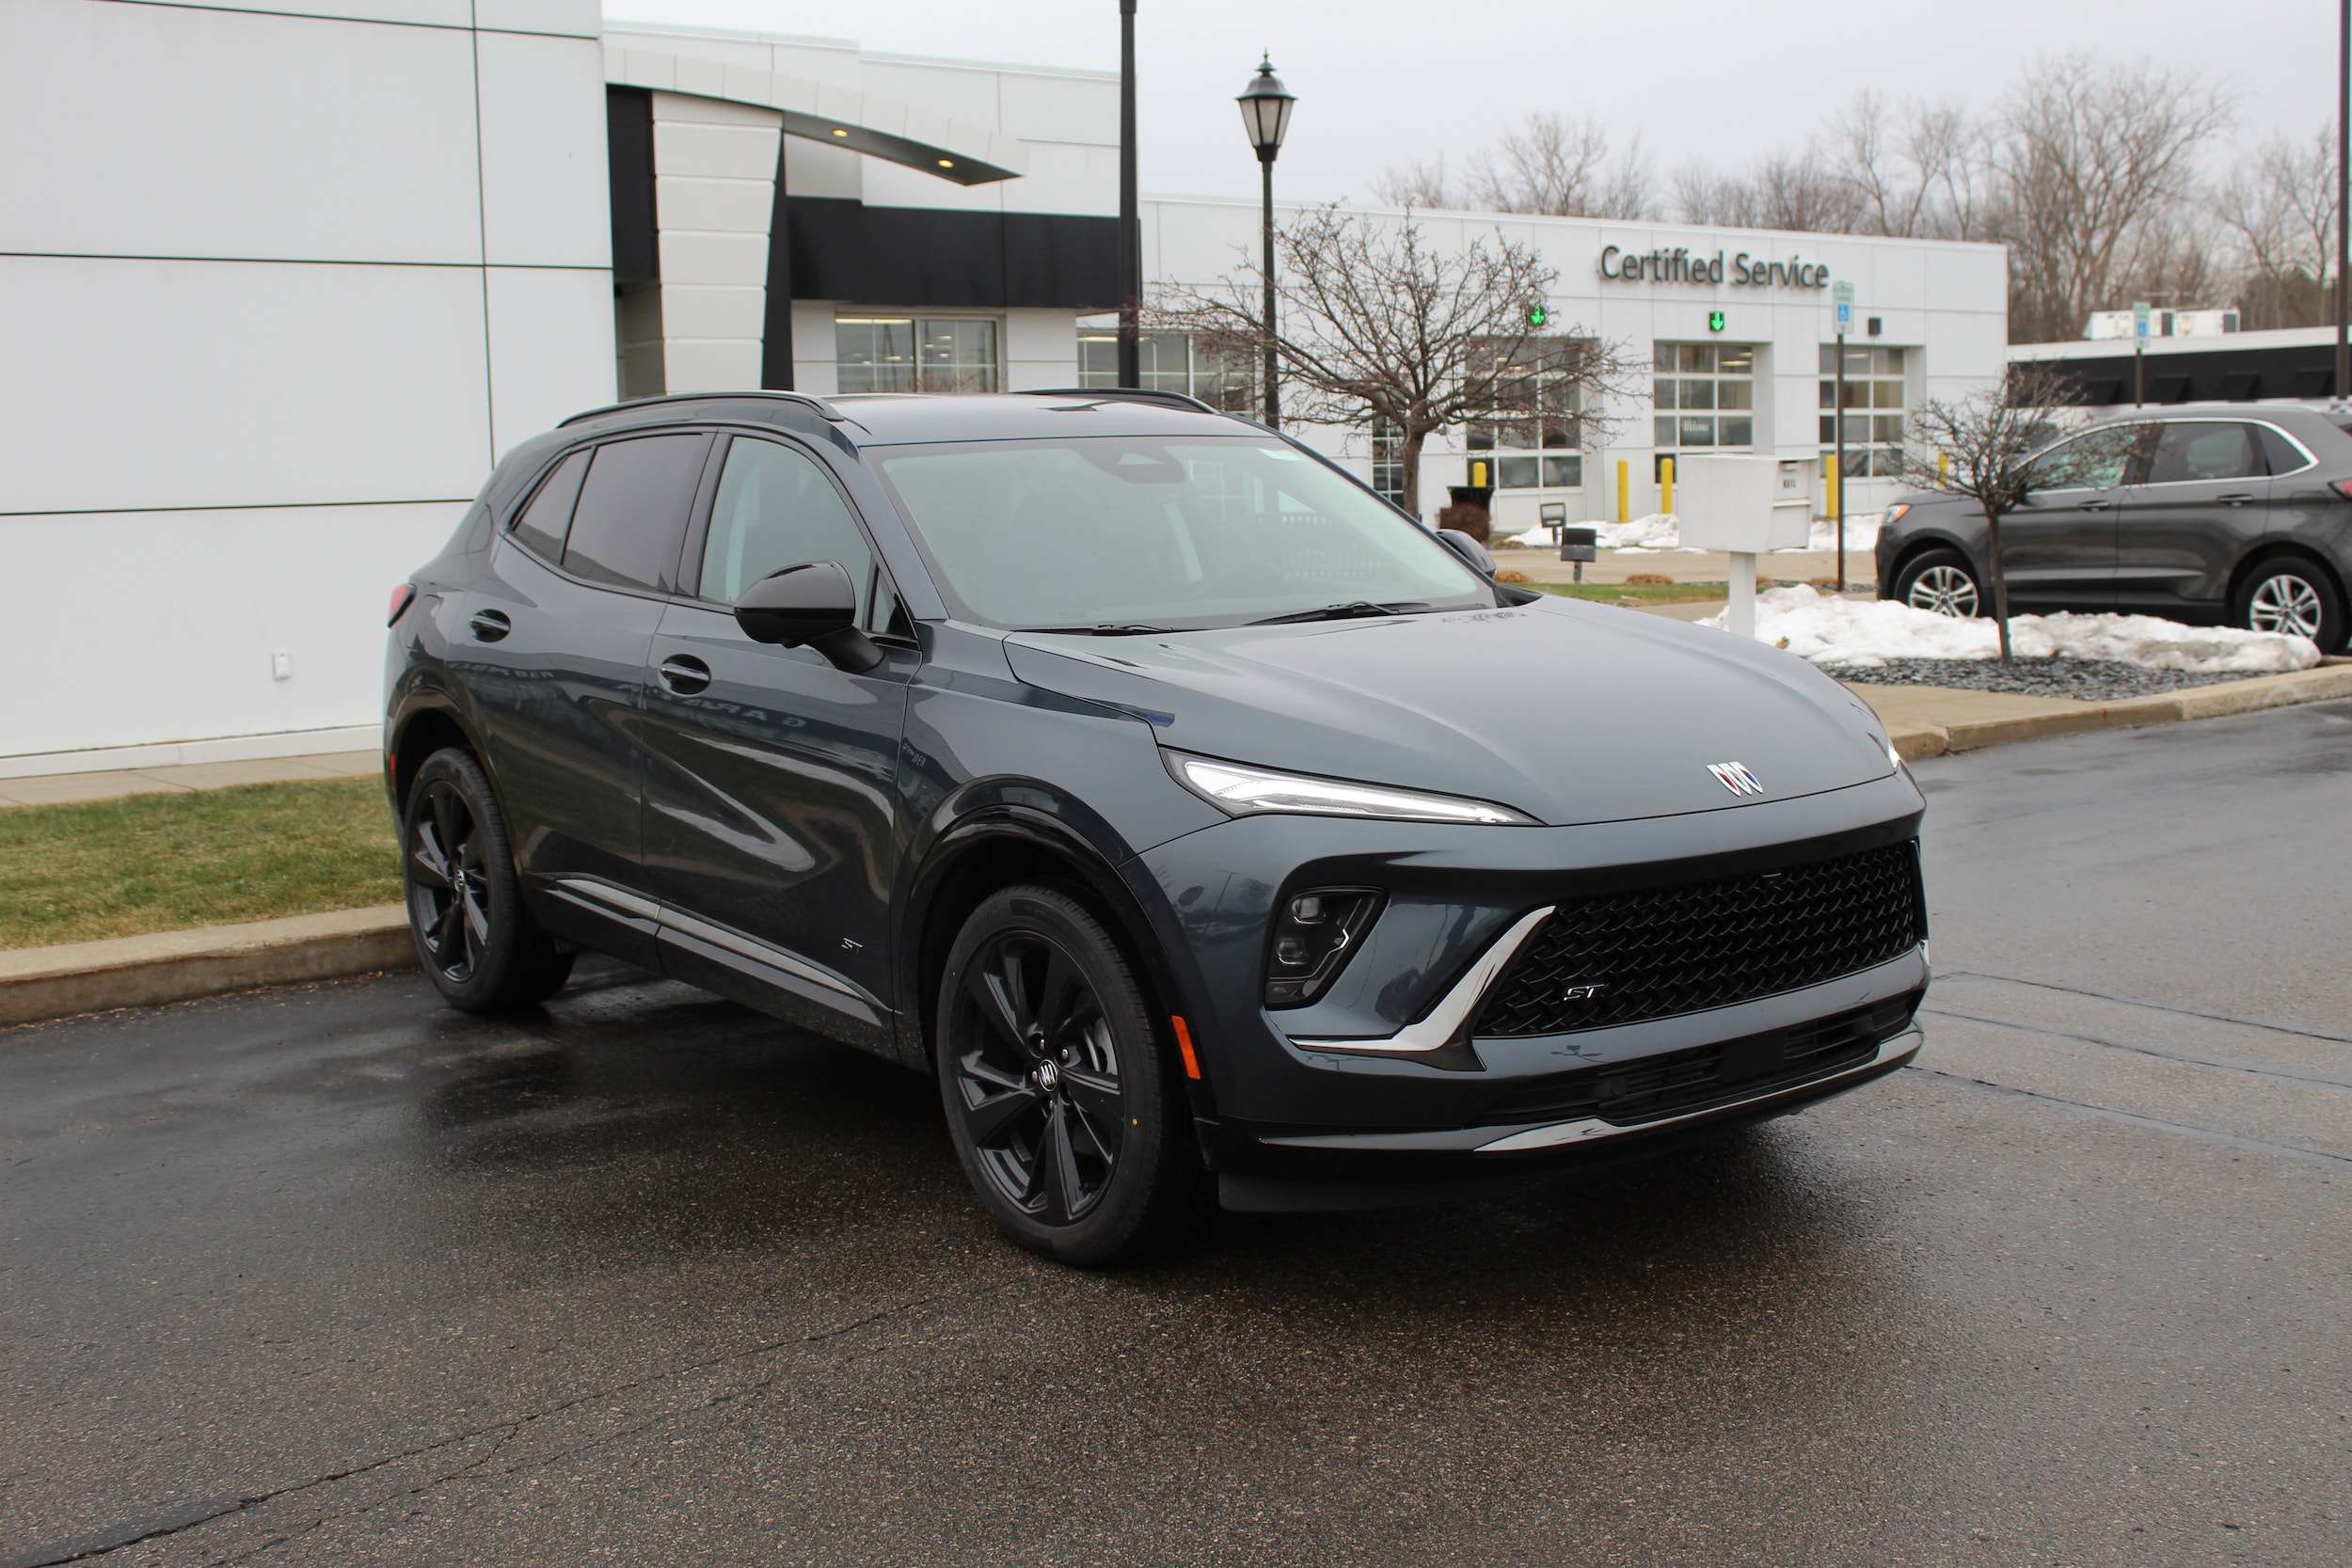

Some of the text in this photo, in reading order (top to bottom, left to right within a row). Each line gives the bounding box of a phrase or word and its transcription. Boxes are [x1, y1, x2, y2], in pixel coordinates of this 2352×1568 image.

[1600, 244, 1830, 288] Certified Service
[1564, 984, 1605, 1001] ST
